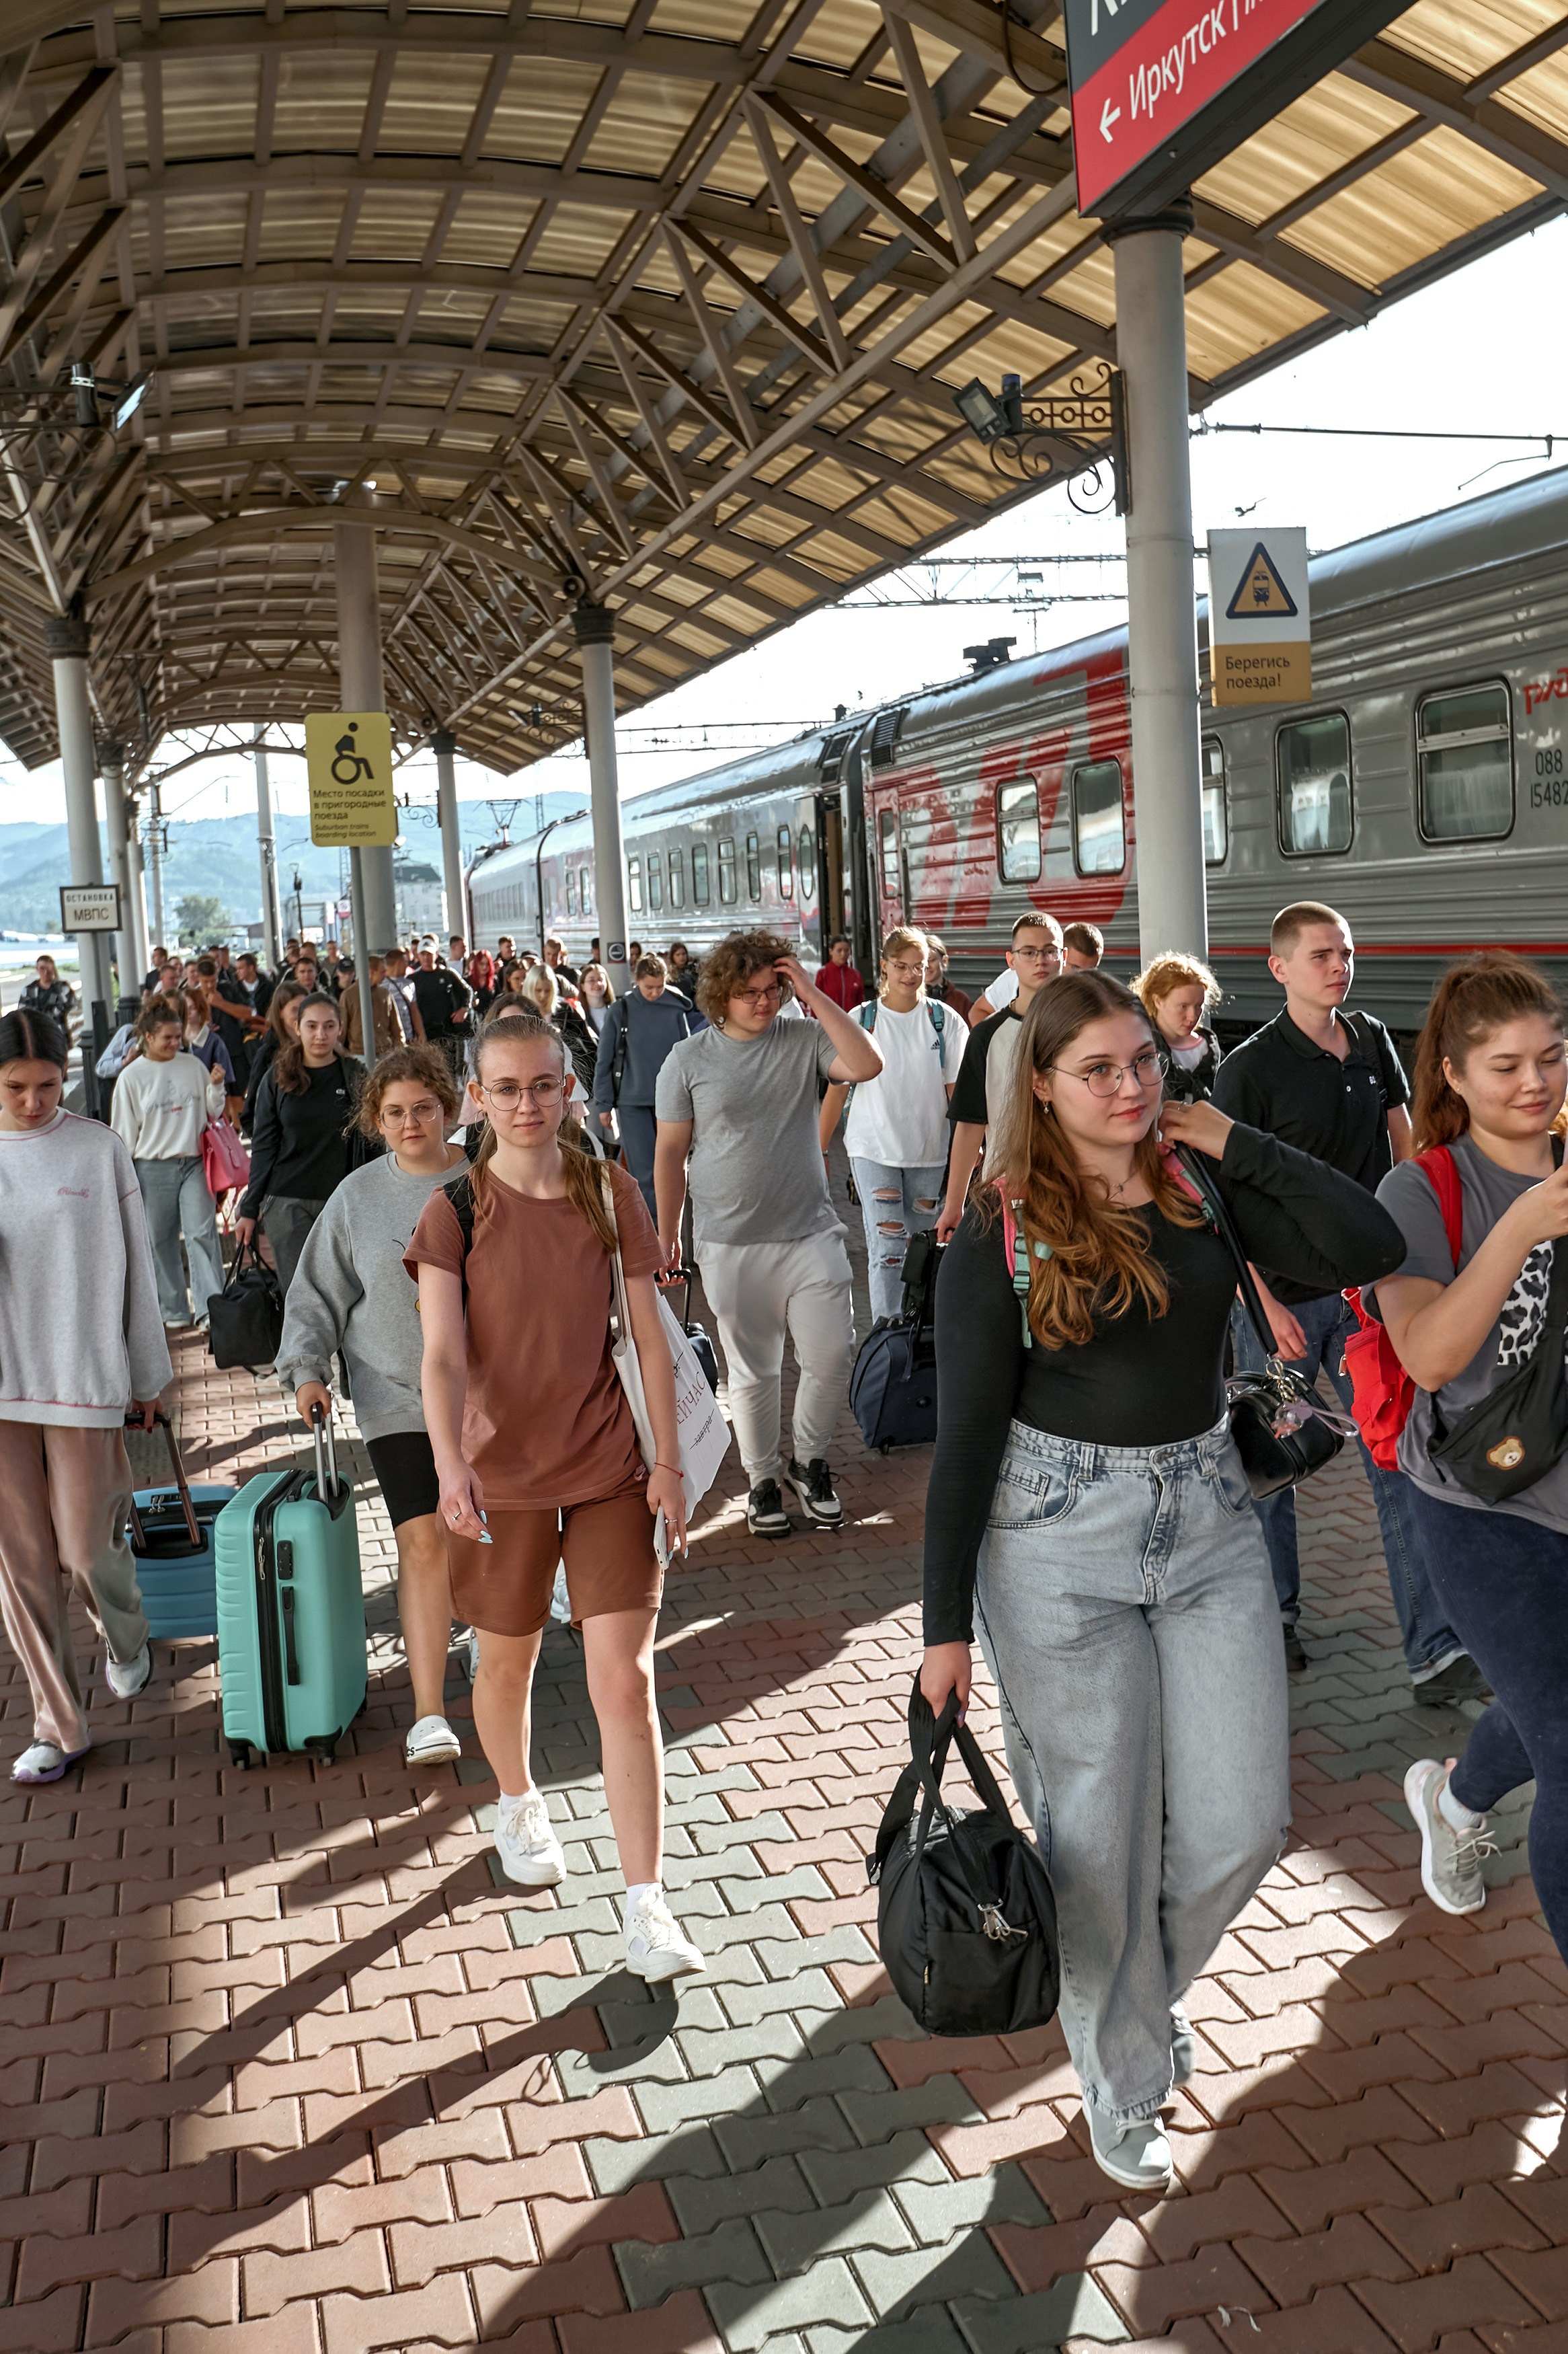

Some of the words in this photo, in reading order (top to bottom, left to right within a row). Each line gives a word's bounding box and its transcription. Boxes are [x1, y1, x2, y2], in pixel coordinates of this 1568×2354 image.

[1130, 0, 1227, 121] Иркутск
[1225, 656, 1290, 673] Берегись
[1226, 673, 1282, 689] поезда!
[1535, 749, 1563, 775] 088
[313, 790, 344, 798] Место
[346, 790, 385, 798] посадки
[1530, 780, 1568, 808] 15482
[321, 800, 386, 810] пригородные
[66, 893, 114, 903] ОСТАНОВКА
[74, 907, 109, 921] МВПС
[676, 1371, 705, 1425] ЕЙЧАС
